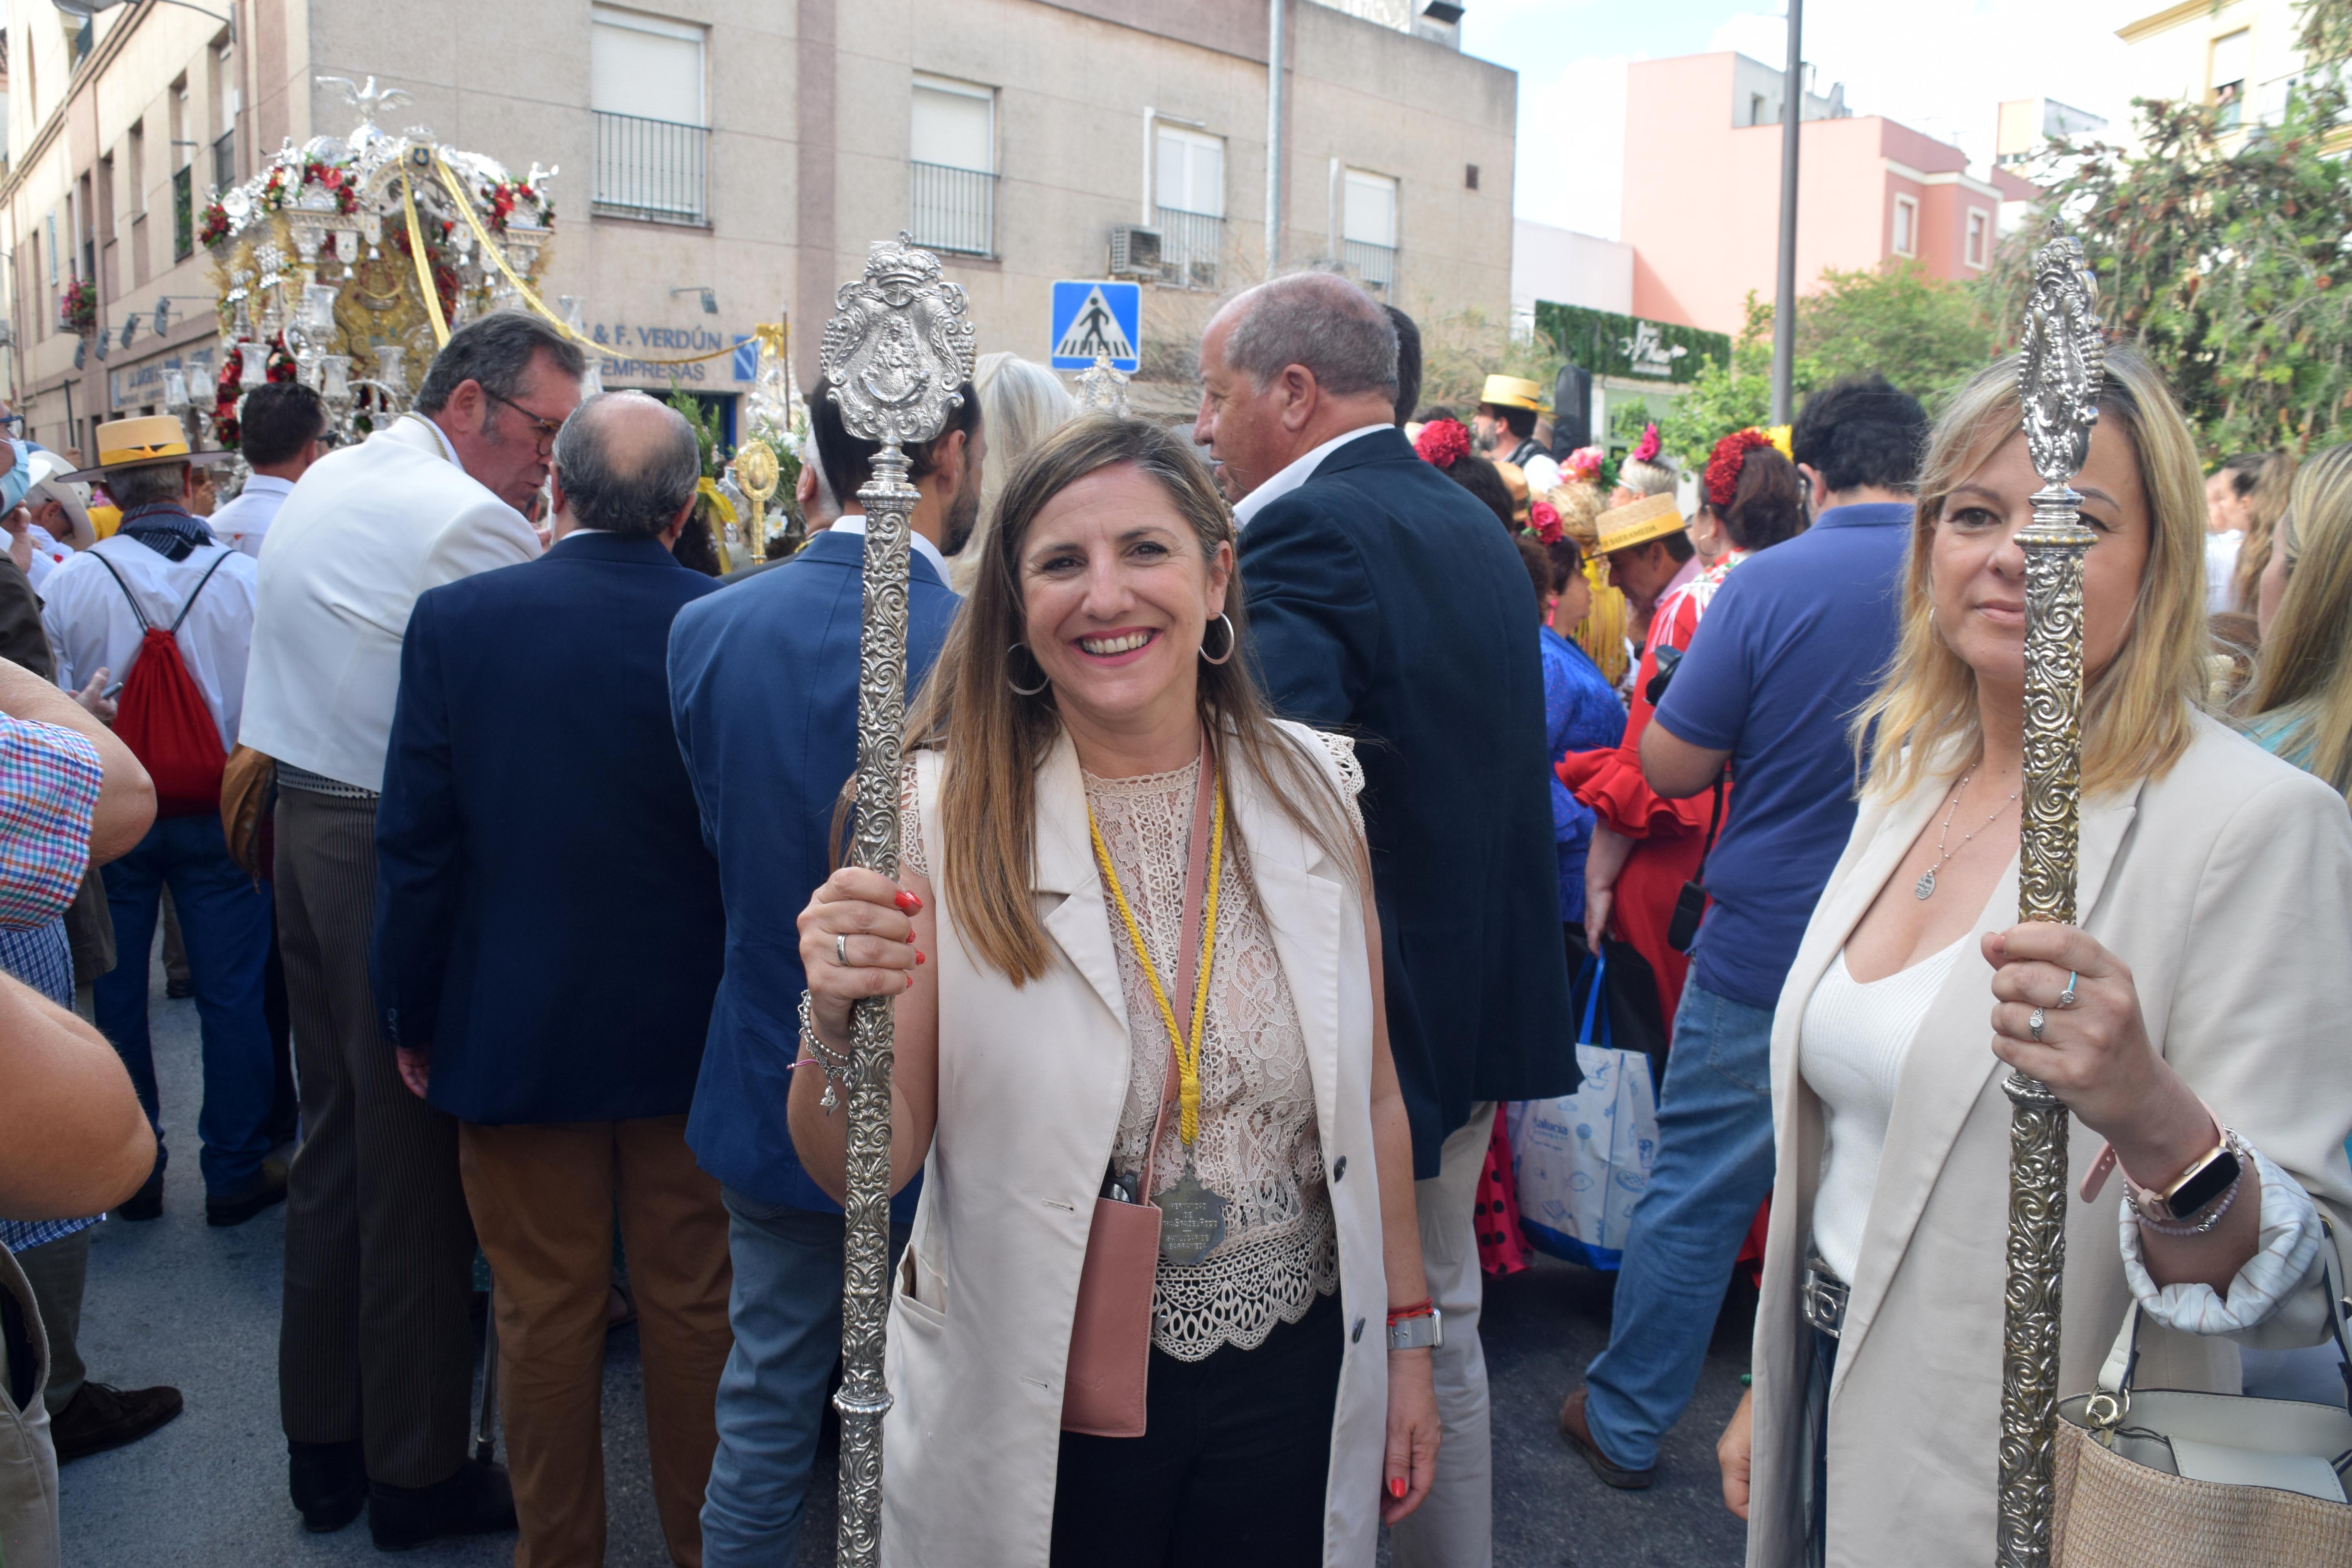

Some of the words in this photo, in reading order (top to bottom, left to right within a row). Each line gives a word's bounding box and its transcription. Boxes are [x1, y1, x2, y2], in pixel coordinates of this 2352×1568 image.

[593, 323, 609, 344] &
[615, 324, 632, 345] F.
[637, 325, 722, 351] VERDÚN
[601, 357, 704, 381] EMPRESAS
